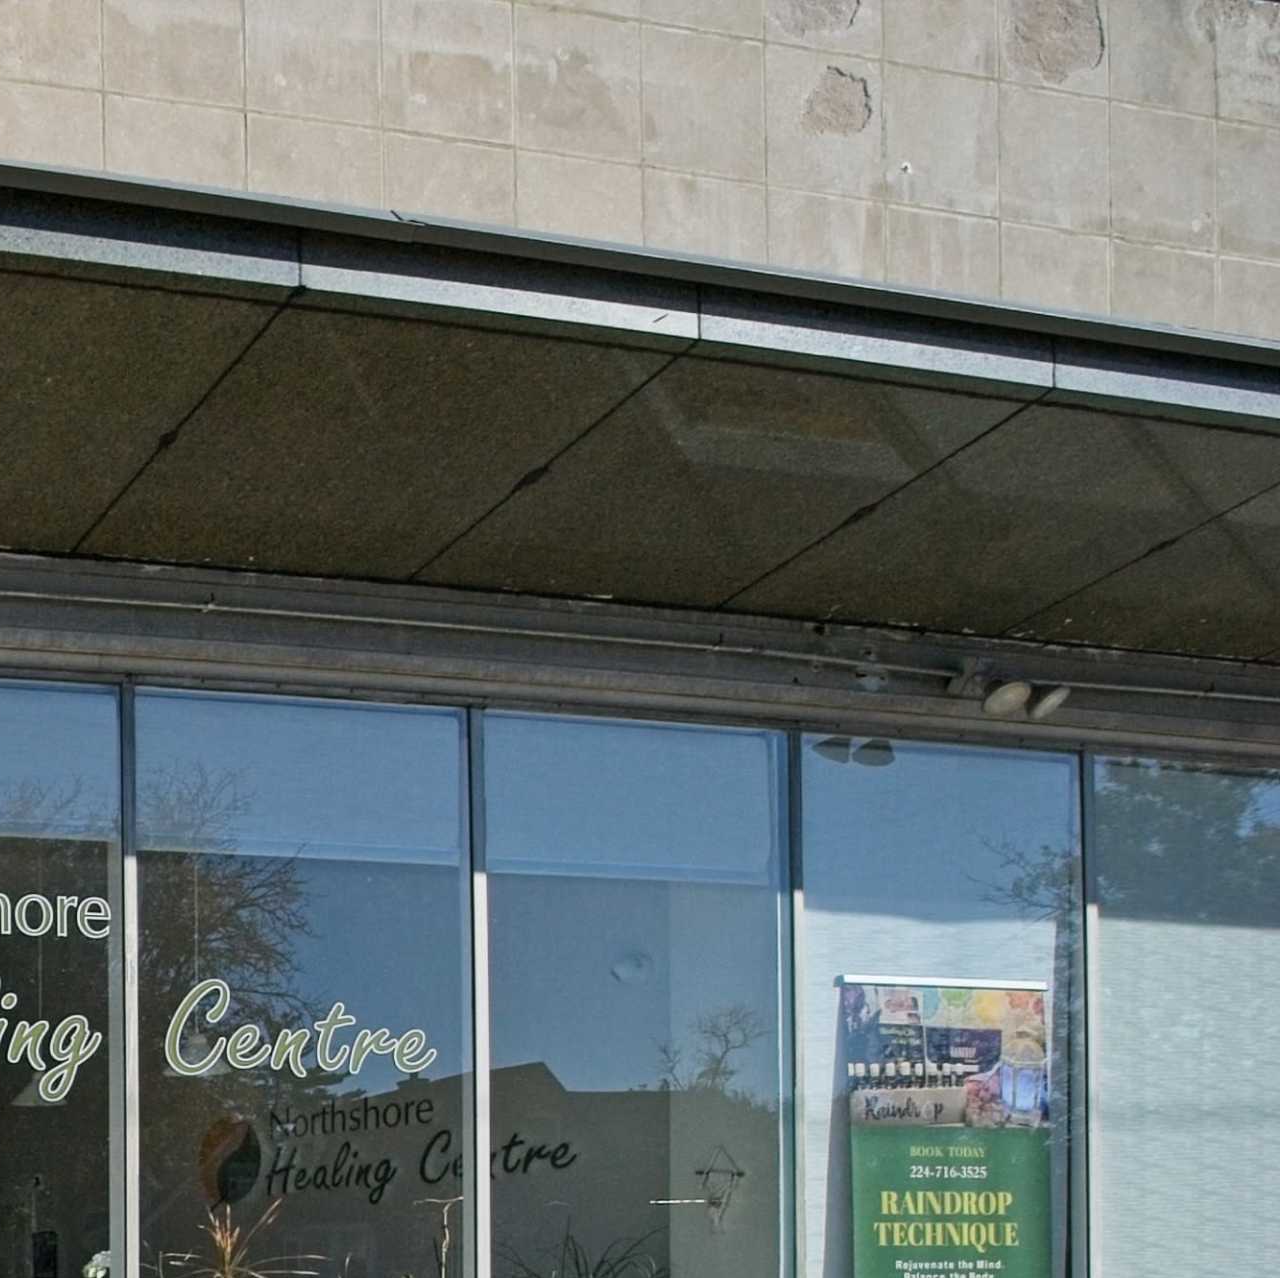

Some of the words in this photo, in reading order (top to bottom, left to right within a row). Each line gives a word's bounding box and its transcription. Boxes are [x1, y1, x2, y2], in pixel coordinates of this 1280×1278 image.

[164, 978, 437, 1077] Centre
[270, 1097, 435, 1141] Northshore
[865, 1095, 944, 1121] Raindrop
[910, 1146, 944, 1157] BOOK
[949, 1146, 985, 1157] TODAY
[266, 1141, 397, 1205] Healing
[420, 1129, 578, 1184] Cetre
[910, 1166, 987, 1179] 224-716-3525
[880, 1190, 1013, 1215] RAINDROP
[873, 1222, 1020, 1253] TECHNIQUE
[895, 1260, 954, 1271] Rejuvenate
[958, 1260, 973, 1270] the
